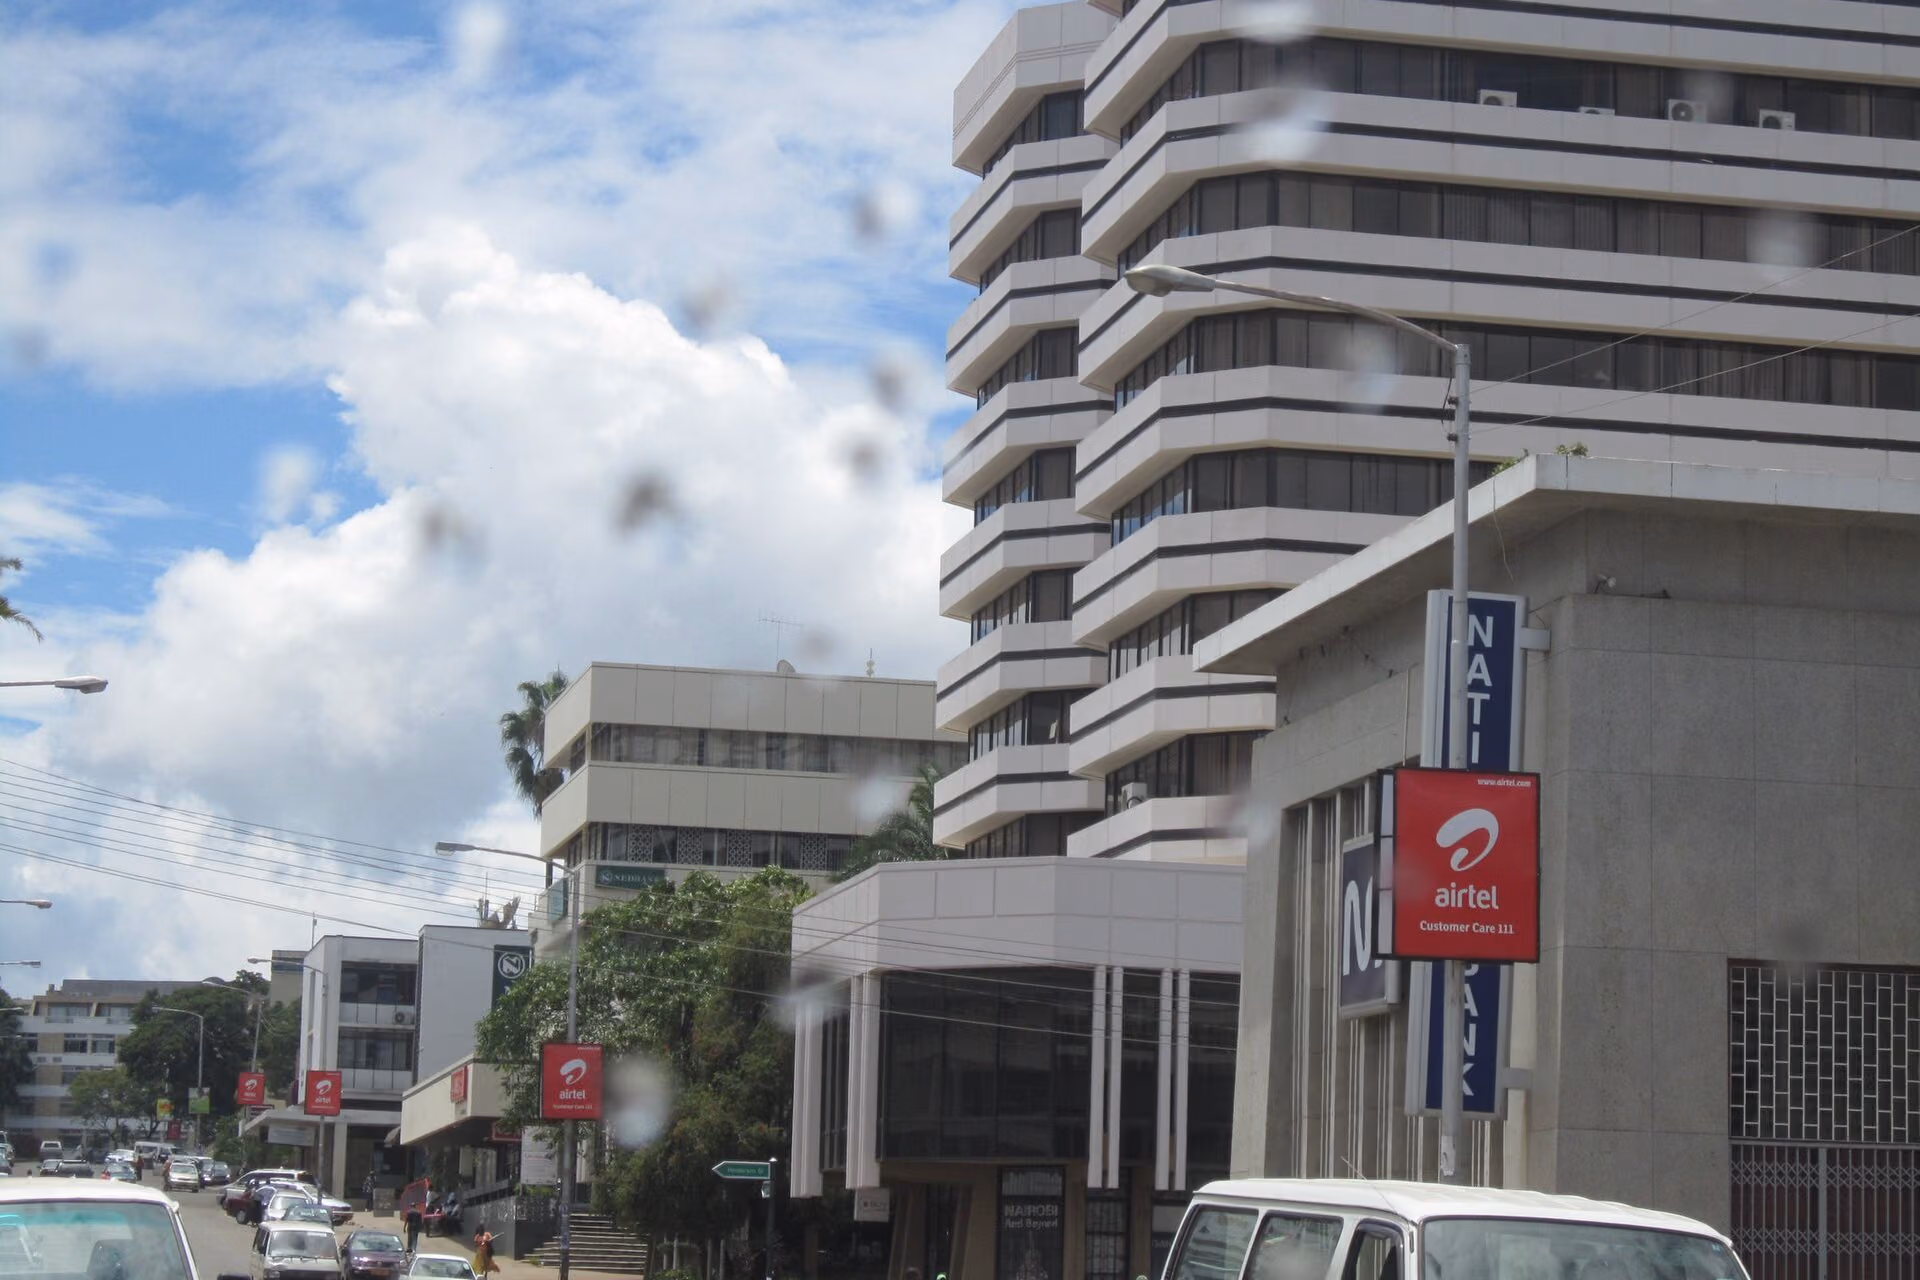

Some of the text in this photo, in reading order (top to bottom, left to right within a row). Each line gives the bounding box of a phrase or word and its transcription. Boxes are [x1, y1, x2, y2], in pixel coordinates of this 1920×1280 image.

[1477, 778, 1532, 788] www.airtel.com
[1435, 882, 1499, 910] airtel
[1420, 920, 1514, 934] Customer Care 111
[559, 1089, 586, 1100] airtel
[1004, 1204, 1059, 1217] NAIROBI
